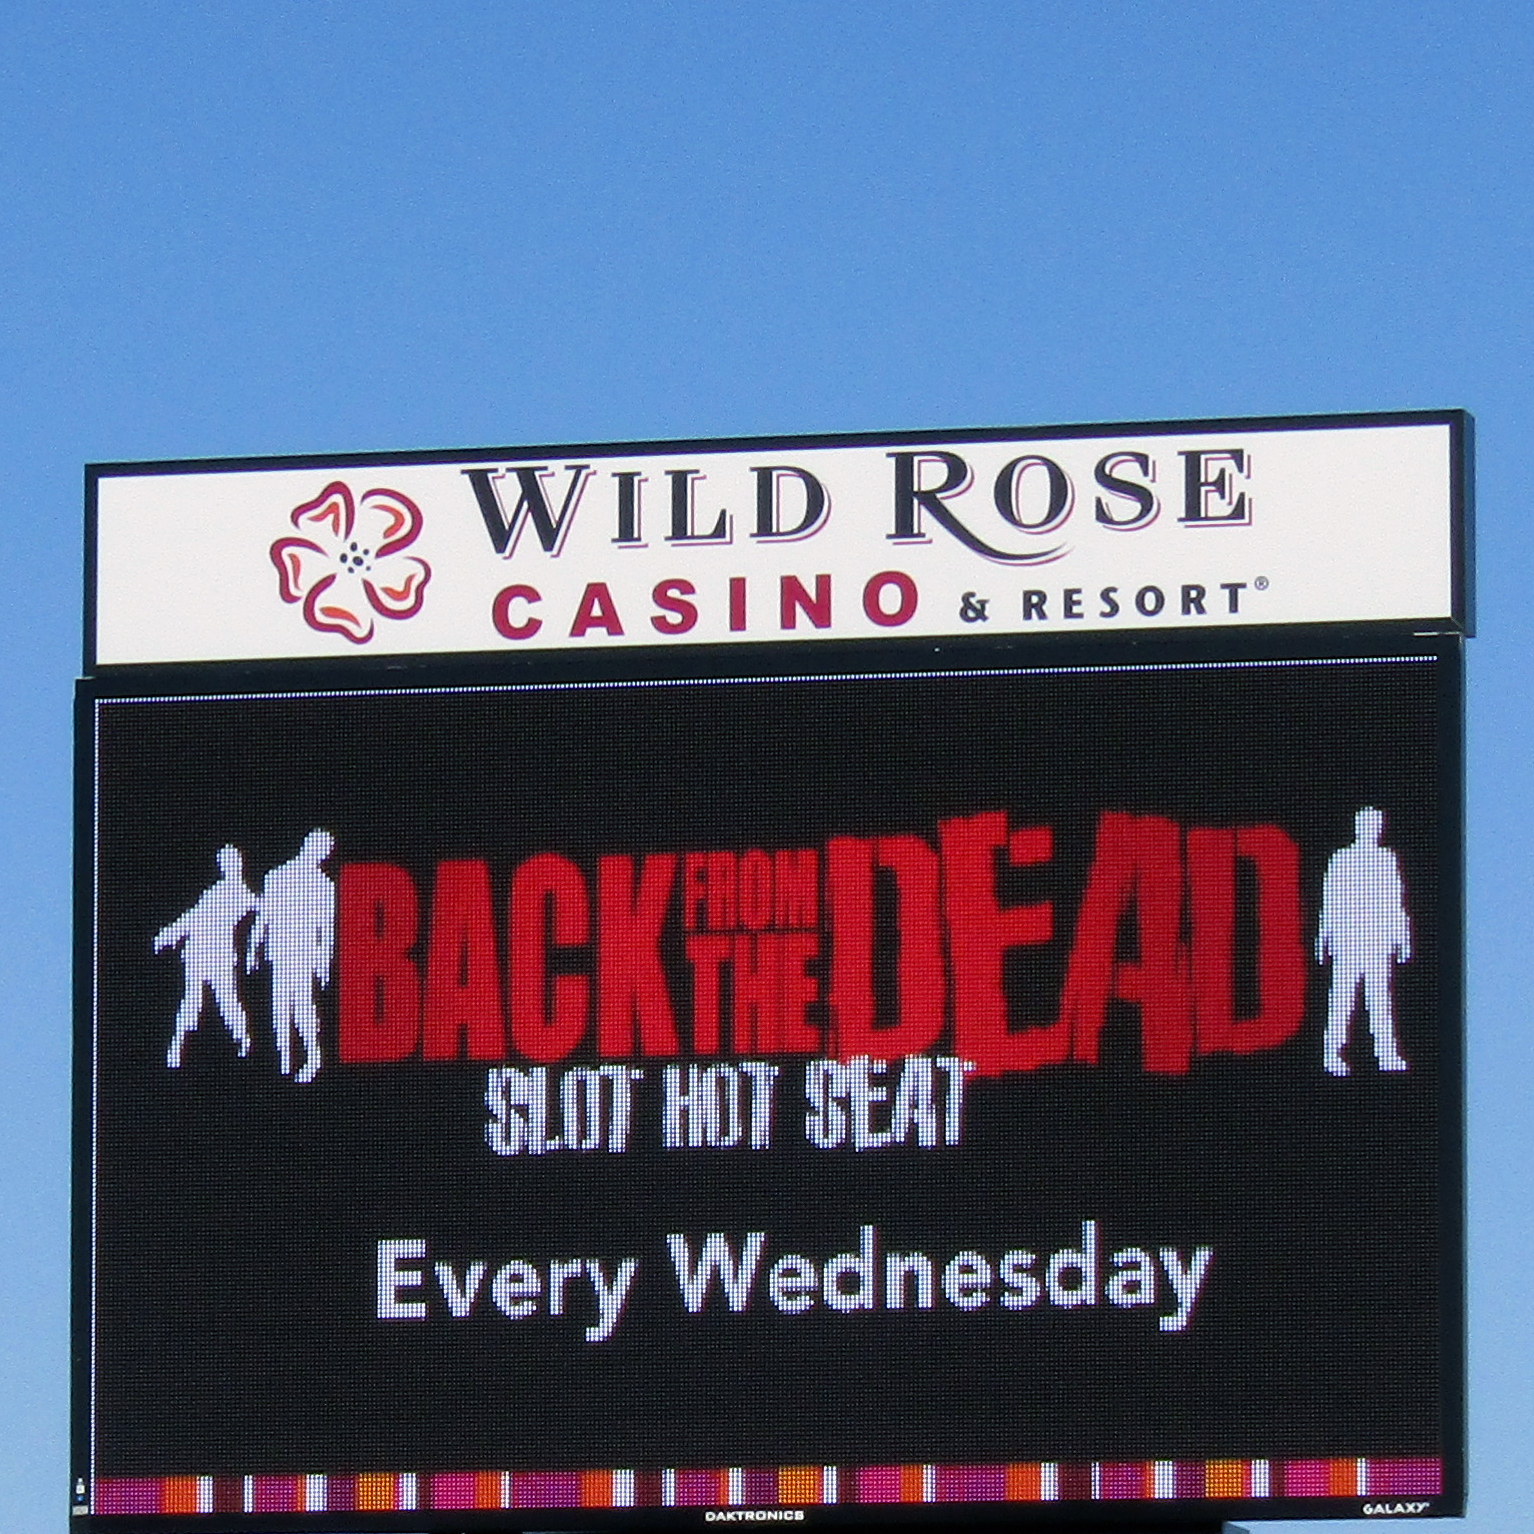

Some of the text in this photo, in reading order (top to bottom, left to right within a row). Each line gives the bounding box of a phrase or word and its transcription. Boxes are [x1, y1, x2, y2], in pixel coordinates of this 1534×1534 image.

[461, 447, 1253, 567] WILD ROSE
[492, 570, 918, 640] CASINO
[958, 590, 991, 623] &
[338, 810, 1308, 1079] BACK FROM THE DEAD
[483, 1053, 976, 1157] SLOT HOT SEAT
[375, 1219, 1215, 1343] Every Wednesday
[704, 1510, 805, 1522] DAKTRONICS
